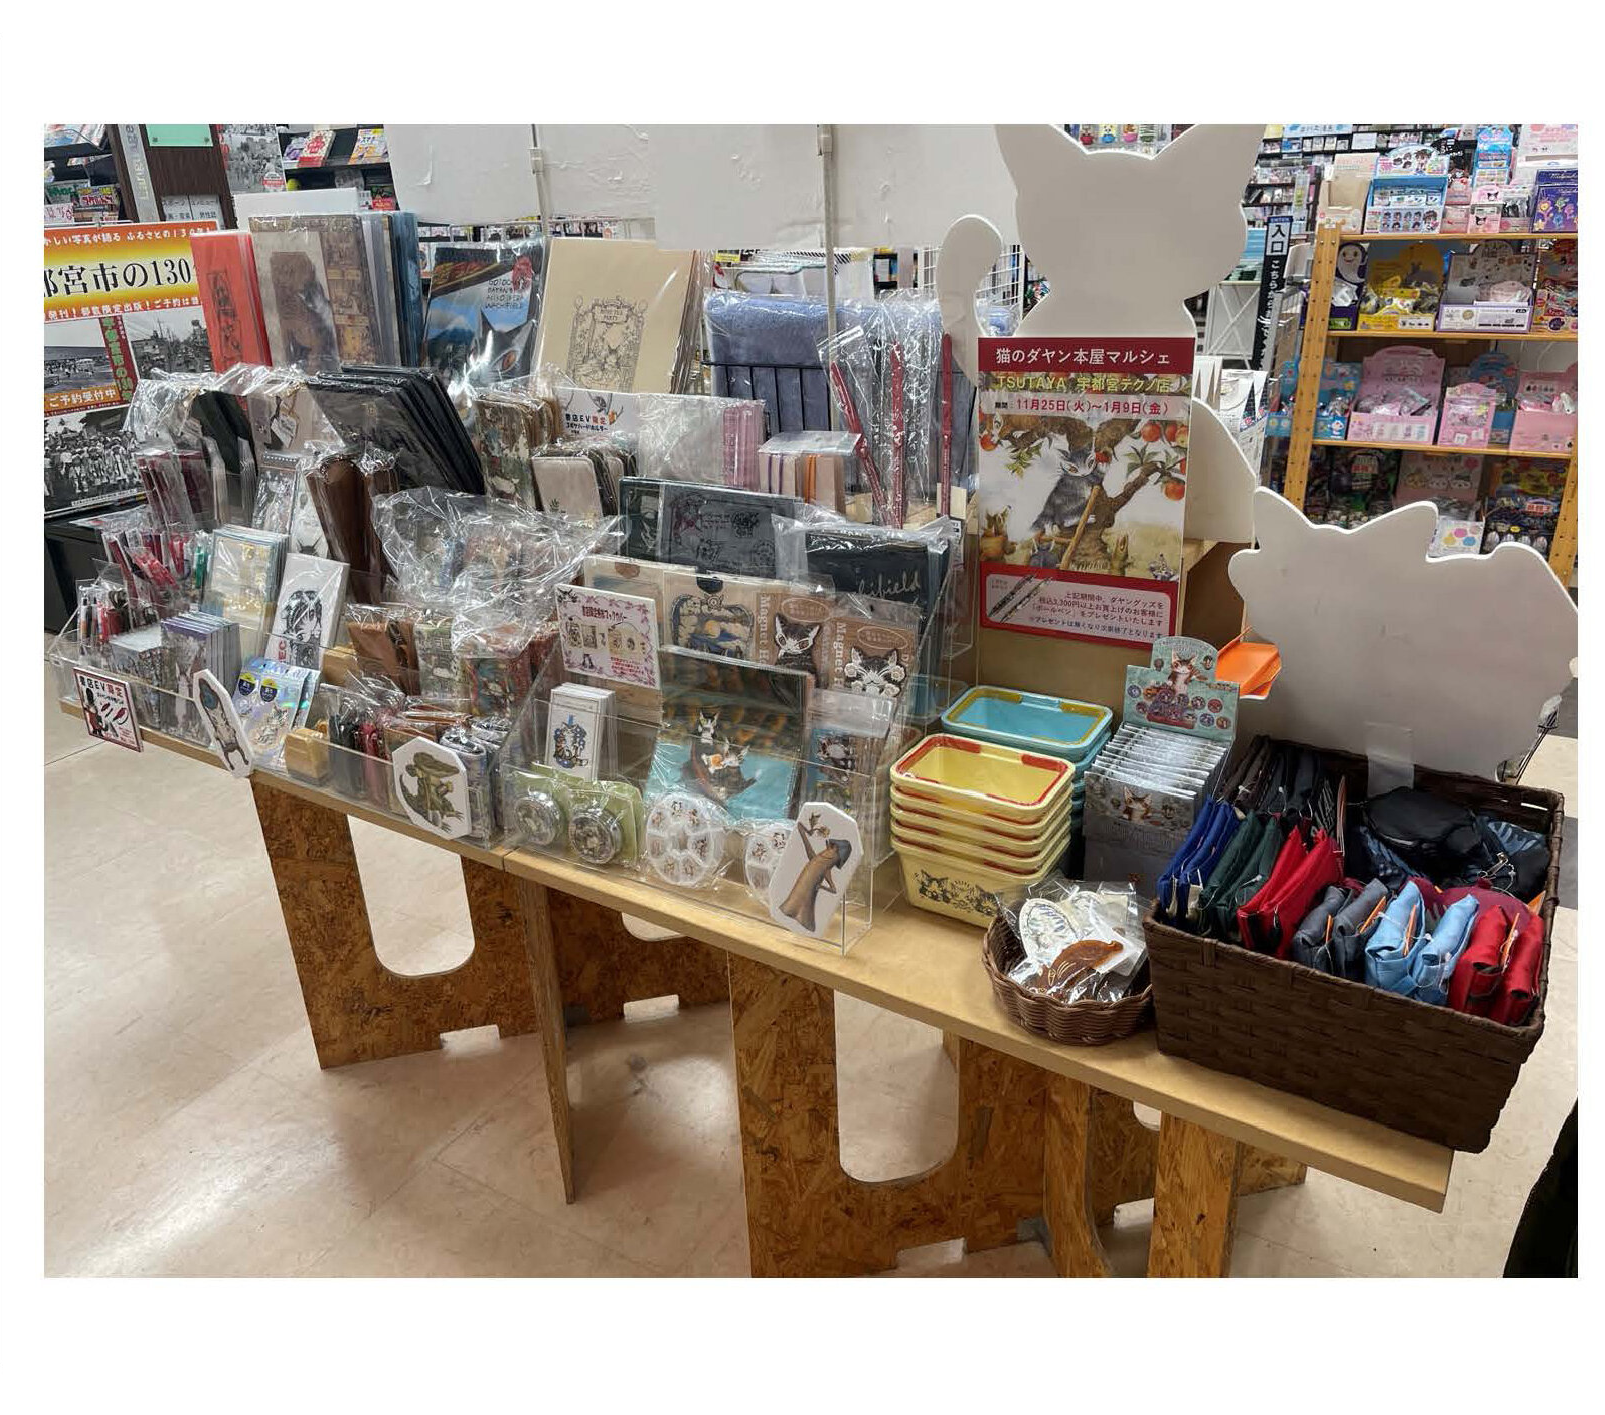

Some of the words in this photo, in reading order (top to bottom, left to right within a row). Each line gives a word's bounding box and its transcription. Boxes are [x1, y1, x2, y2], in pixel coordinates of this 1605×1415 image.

[1271, 224, 1286, 253] 入口
[44, 258, 197, 297] 宮市の130
[996, 348, 1170, 365] 猫のダヤン本屋マルシェ
[997, 376, 1067, 389] TSUTAYA
[1076, 377, 1171, 393] 宇都宮テクノ店
[757, 596, 772, 648] Magnet
[832, 622, 846, 673] Magnet
